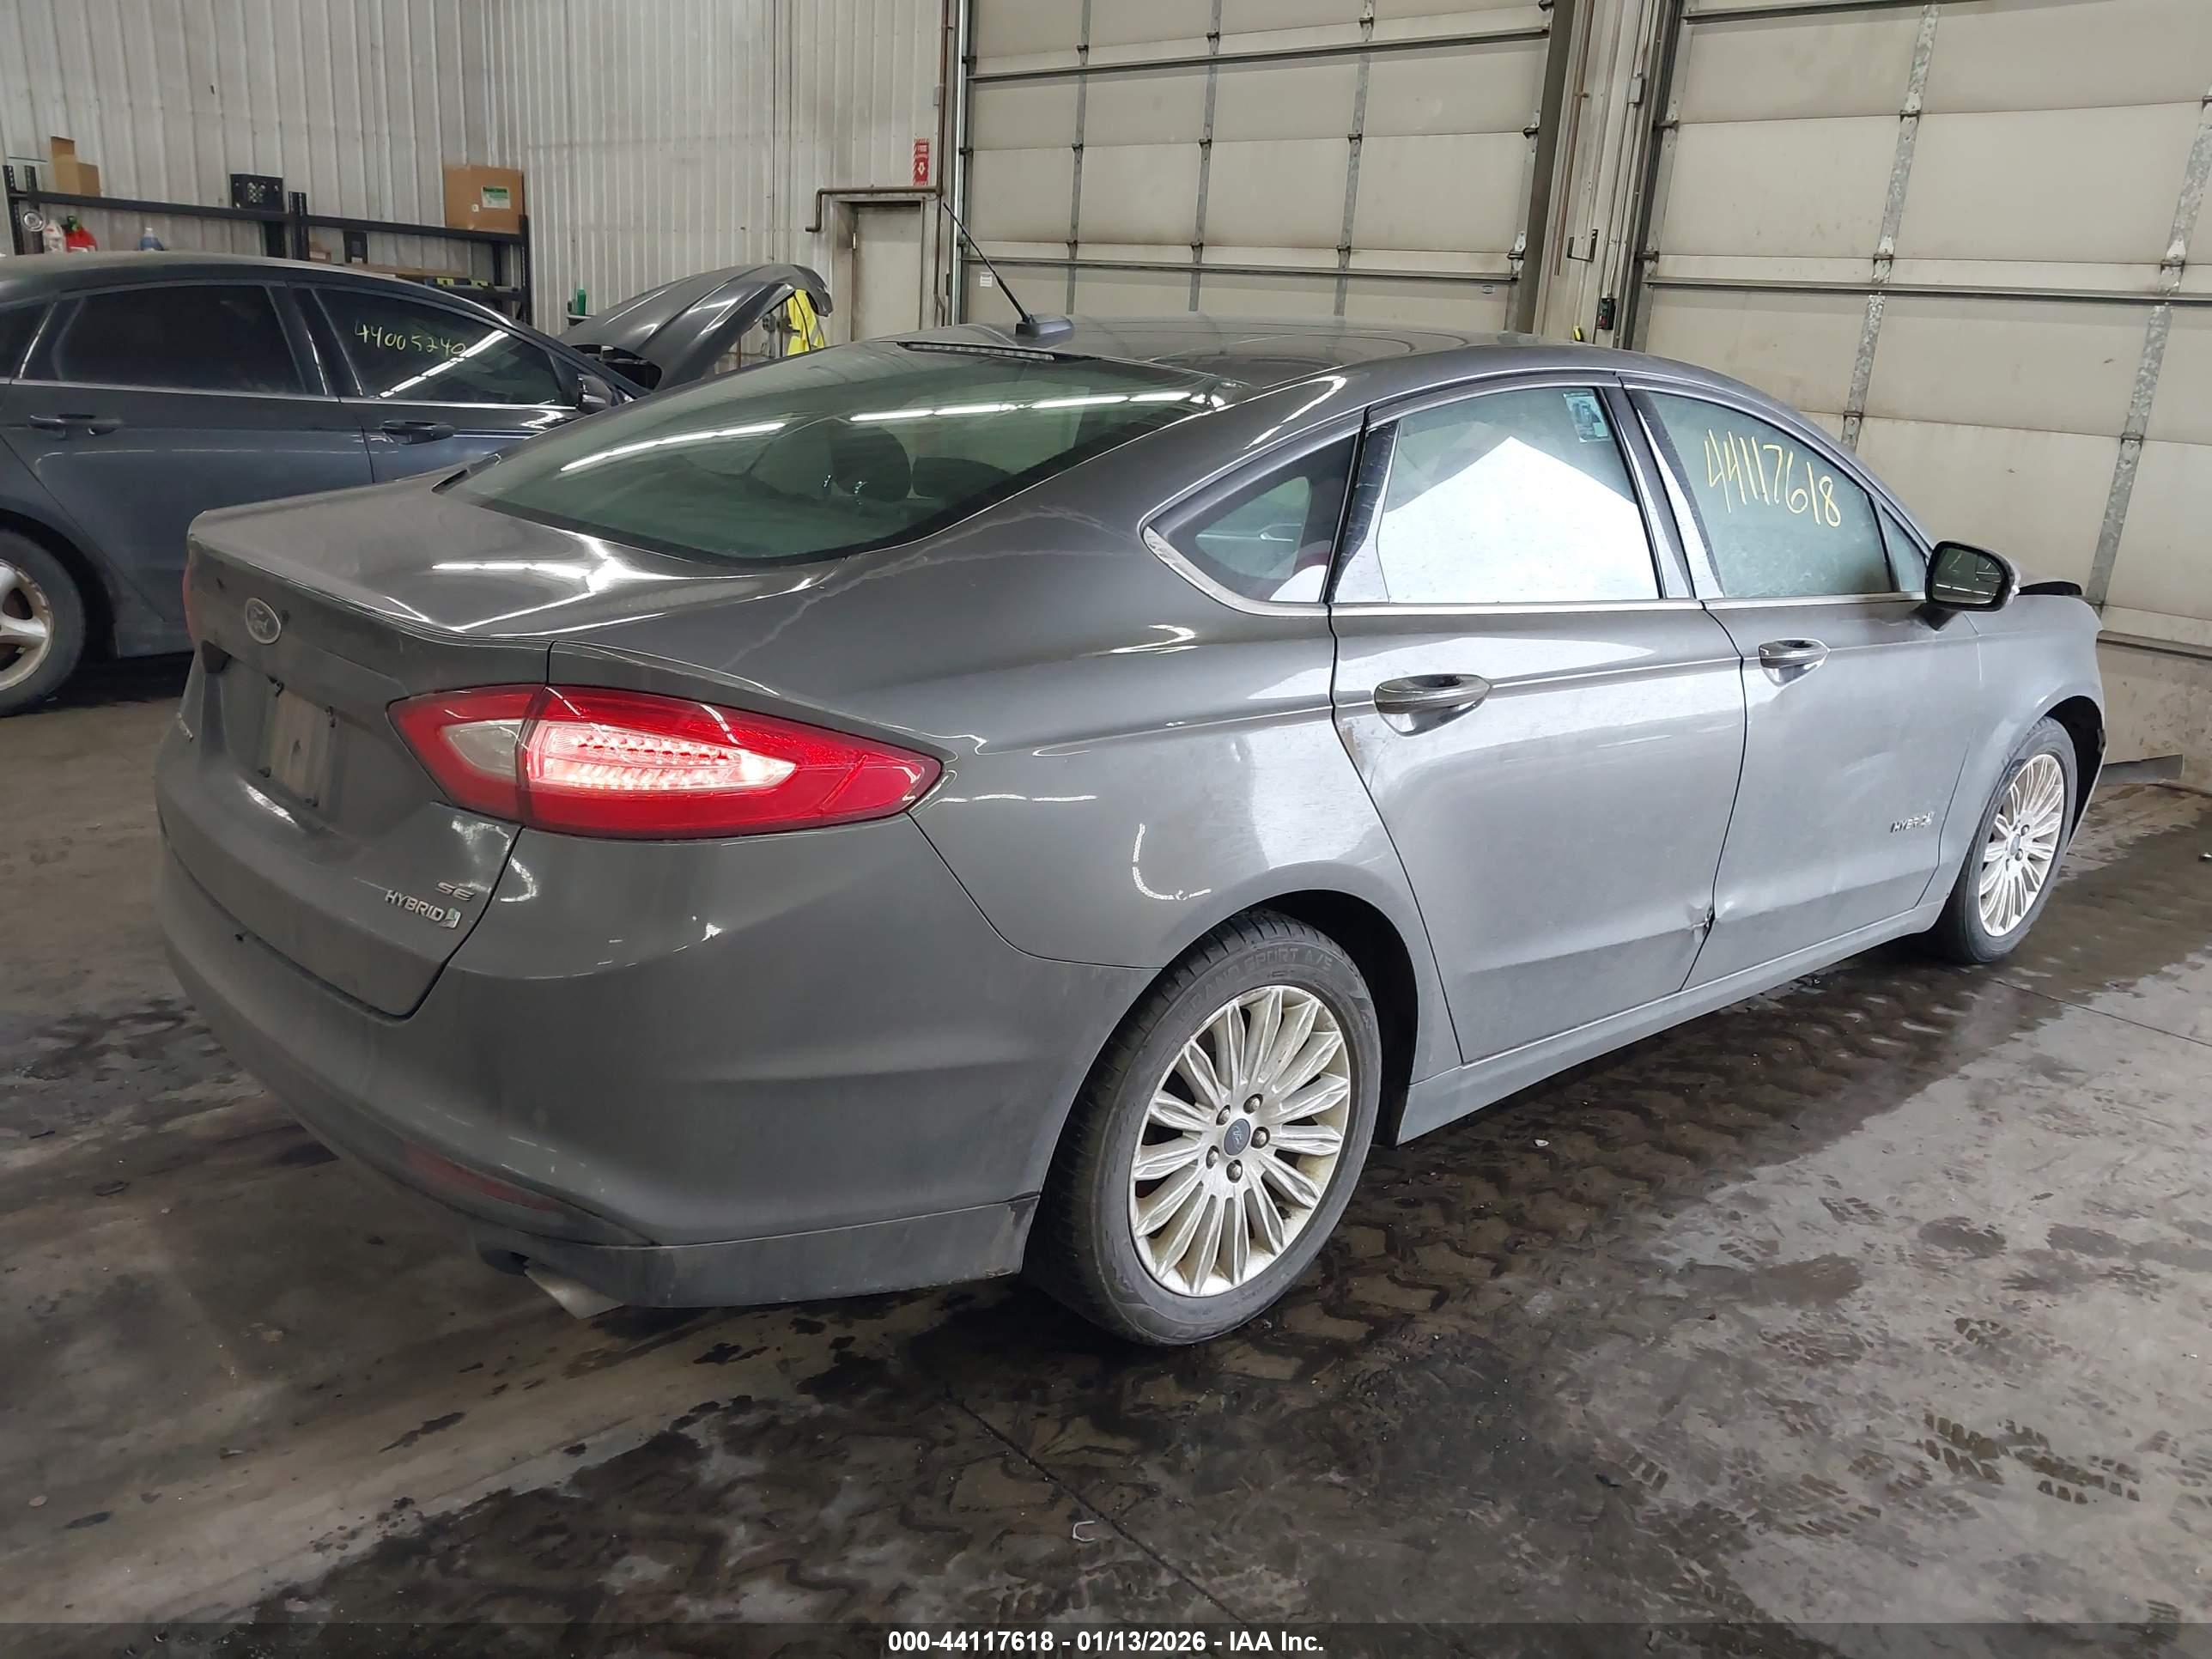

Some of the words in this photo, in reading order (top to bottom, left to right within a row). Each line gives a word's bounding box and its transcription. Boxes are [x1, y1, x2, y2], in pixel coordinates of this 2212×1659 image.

[354, 318, 466, 357] 44005240
[1704, 428, 1841, 528] 44117618
[384, 889, 446, 922] HYBRID
[436, 881, 475, 902] SE
[1243, 947, 1299, 972] SPORT
